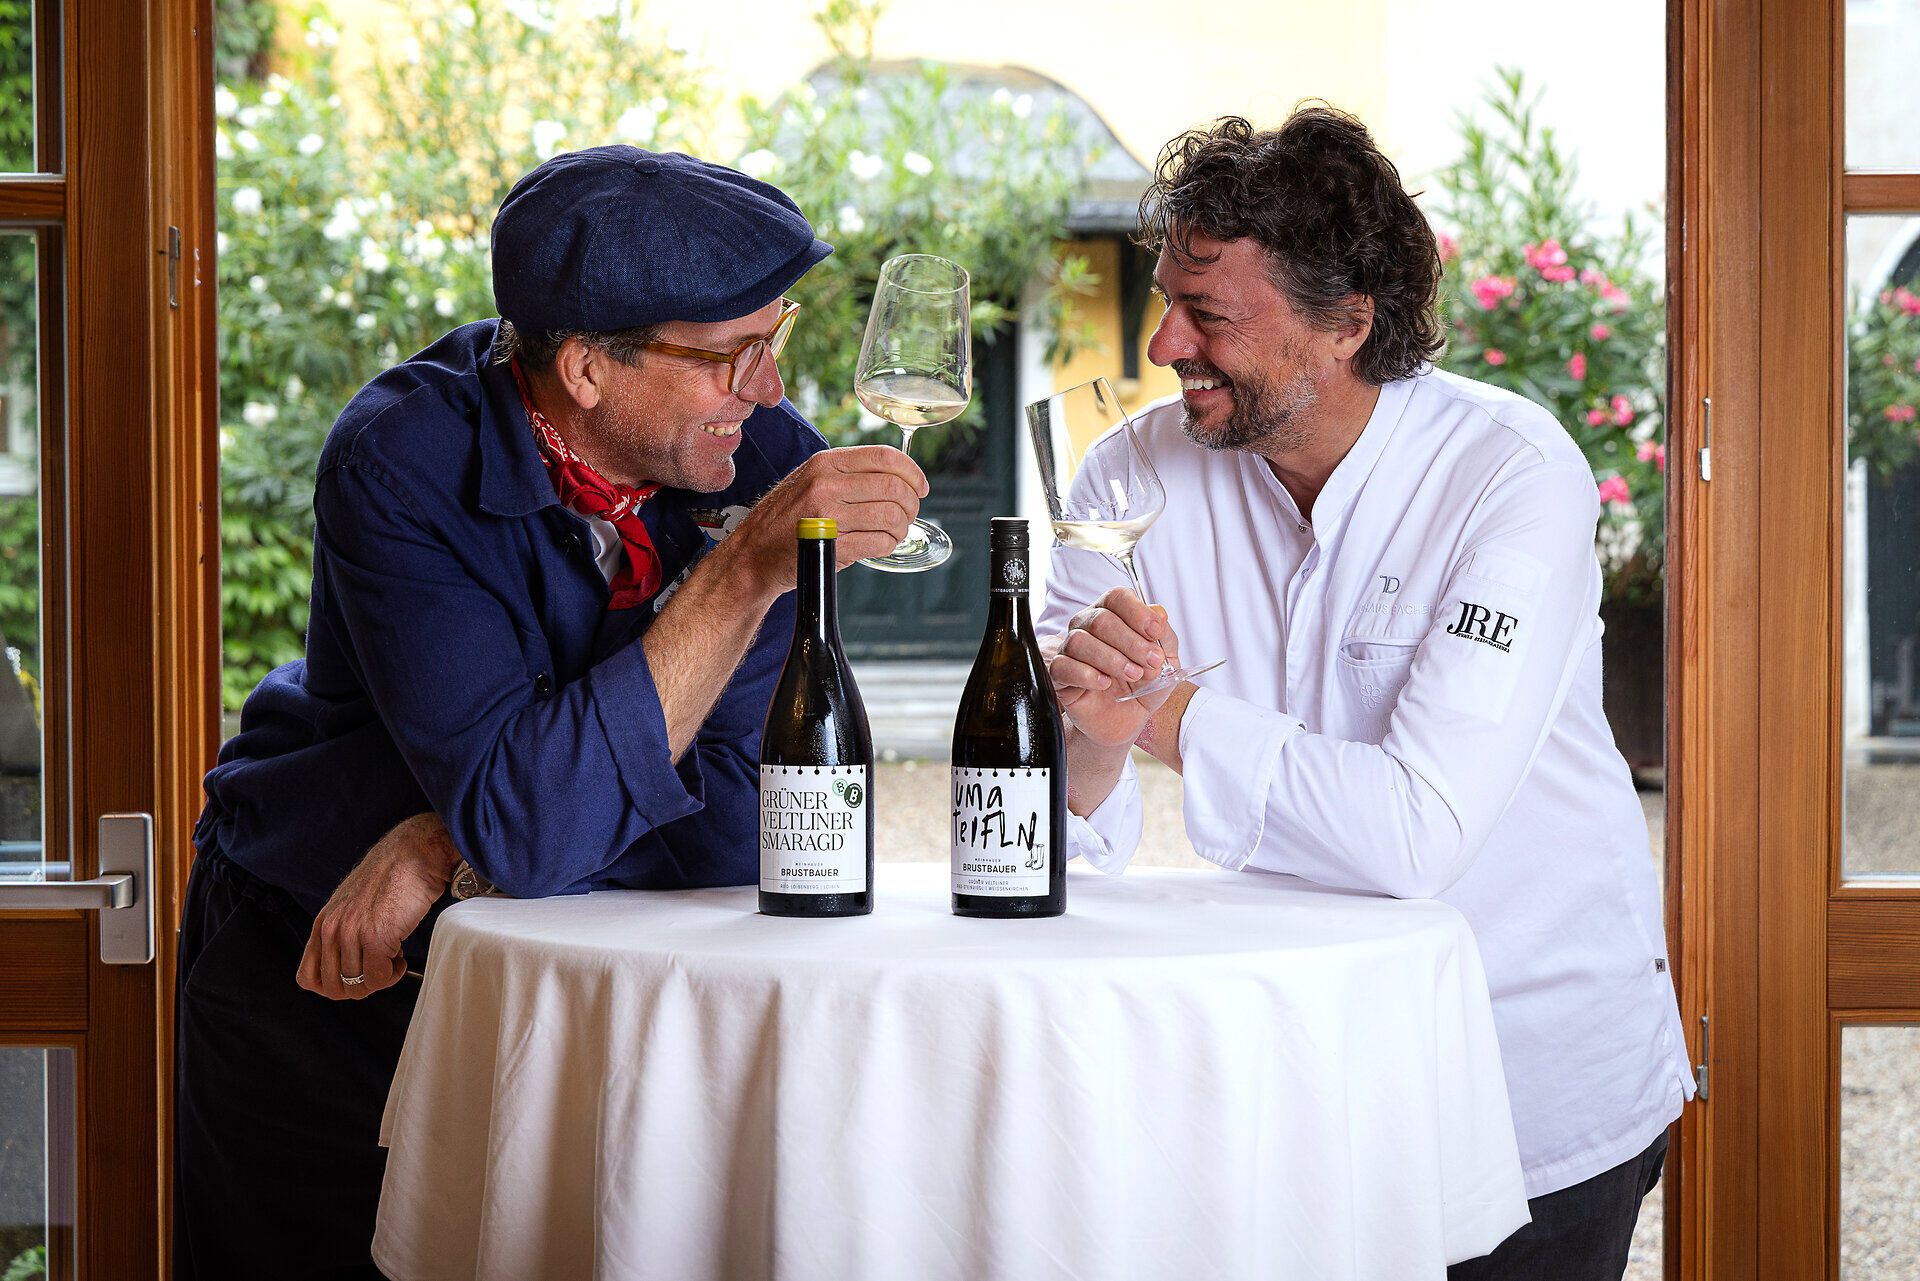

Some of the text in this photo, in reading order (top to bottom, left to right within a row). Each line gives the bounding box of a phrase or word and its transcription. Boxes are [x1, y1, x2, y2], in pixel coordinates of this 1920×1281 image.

[1447, 601, 1519, 648] JRE
[762, 788, 828, 810] GRÜNER
[762, 811, 853, 831] VELTLINER
[762, 831, 844, 852] SMARAGD
[781, 868, 839, 877] BRUSTBAUER
[963, 863, 1017, 874] BRUSTBAUER
